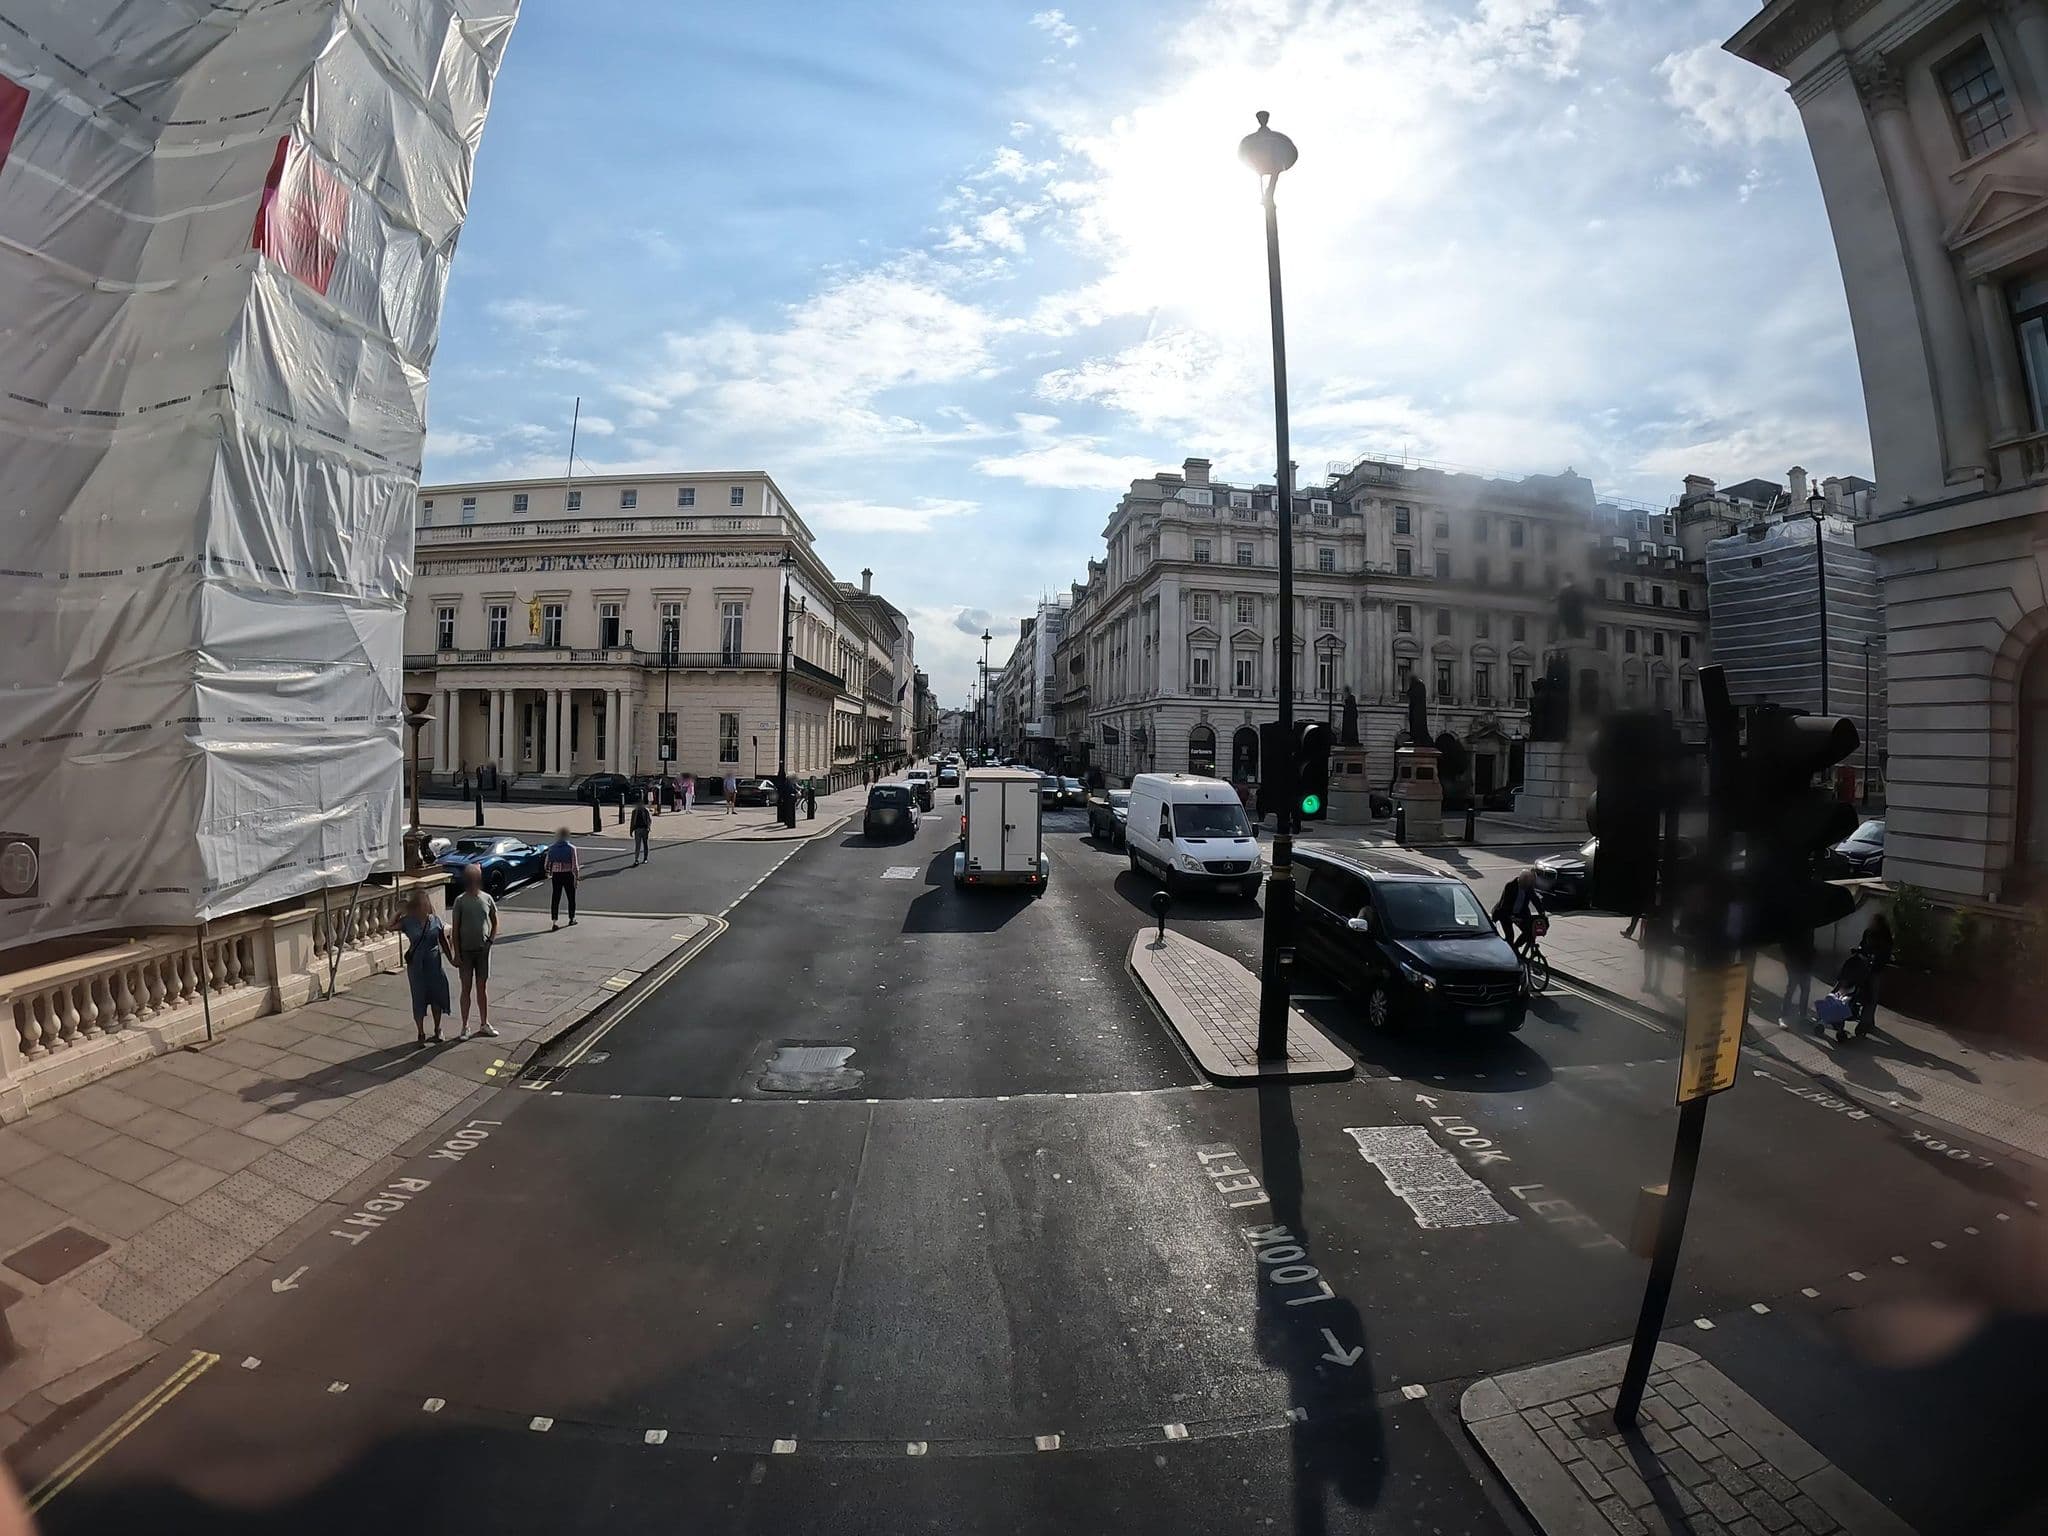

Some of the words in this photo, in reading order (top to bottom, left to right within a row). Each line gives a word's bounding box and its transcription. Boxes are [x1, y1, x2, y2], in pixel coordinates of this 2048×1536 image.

[1783, 1086, 1870, 1120] RIGHT
[428, 1119, 502, 1161] LOOK
[1903, 1130, 1994, 1167] LOOK
[1196, 1151, 1271, 1208] LEFT
[1430, 1116, 1512, 1165] LOOK
[1509, 1183, 1627, 1250] LEFT
[329, 1177, 432, 1246] RIGHT
[1247, 1224, 1336, 1307] LOOK
